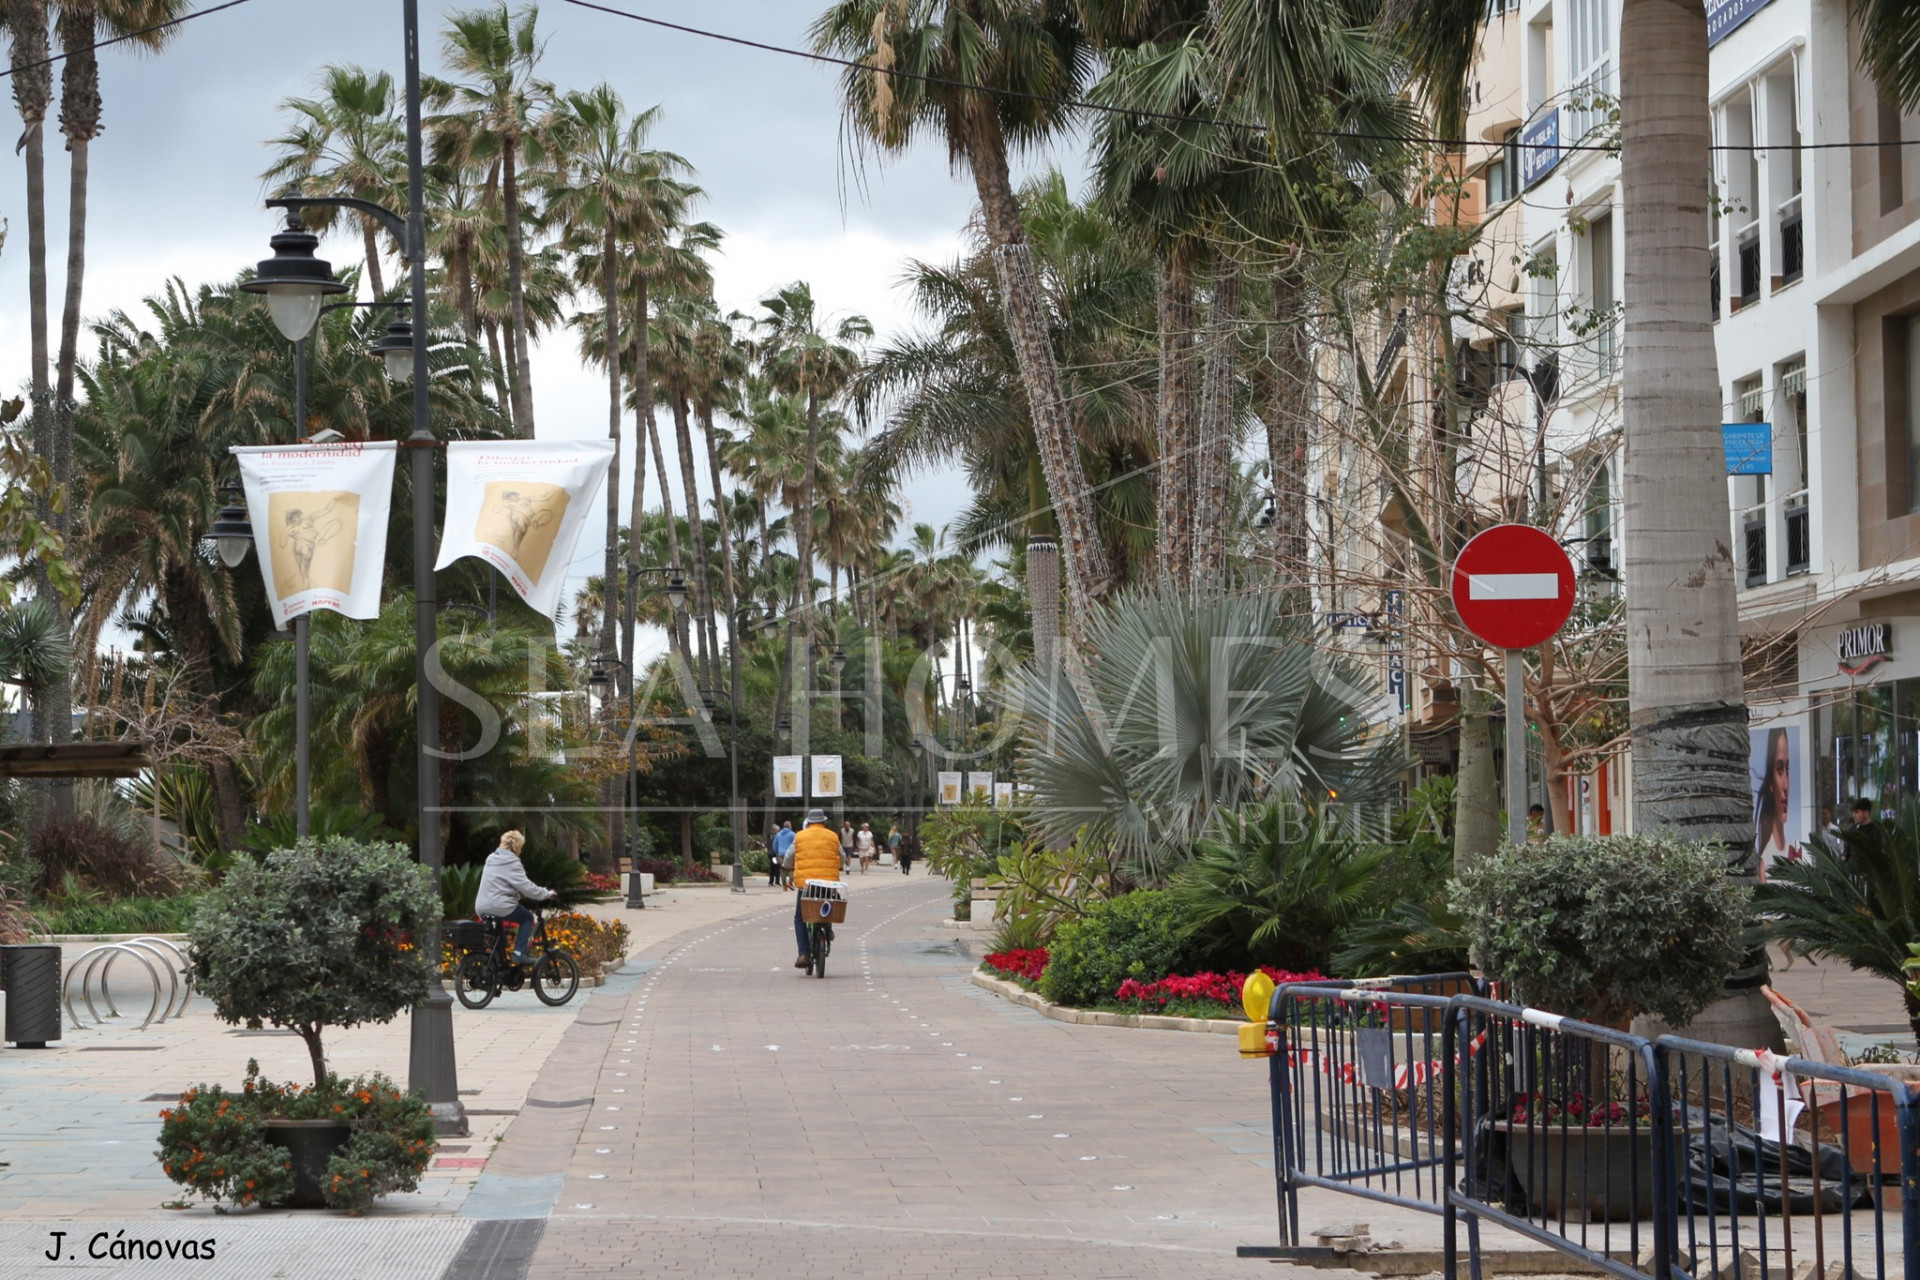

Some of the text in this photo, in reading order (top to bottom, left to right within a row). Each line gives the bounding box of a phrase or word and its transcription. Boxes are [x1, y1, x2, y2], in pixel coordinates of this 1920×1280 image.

[1707, 0, 1744, 37] BOGADOS
[261, 447, 362, 459] la modernidad
[1389, 593, 1403, 712] FARMACI
[1837, 623, 1885, 659] PRIMOR
